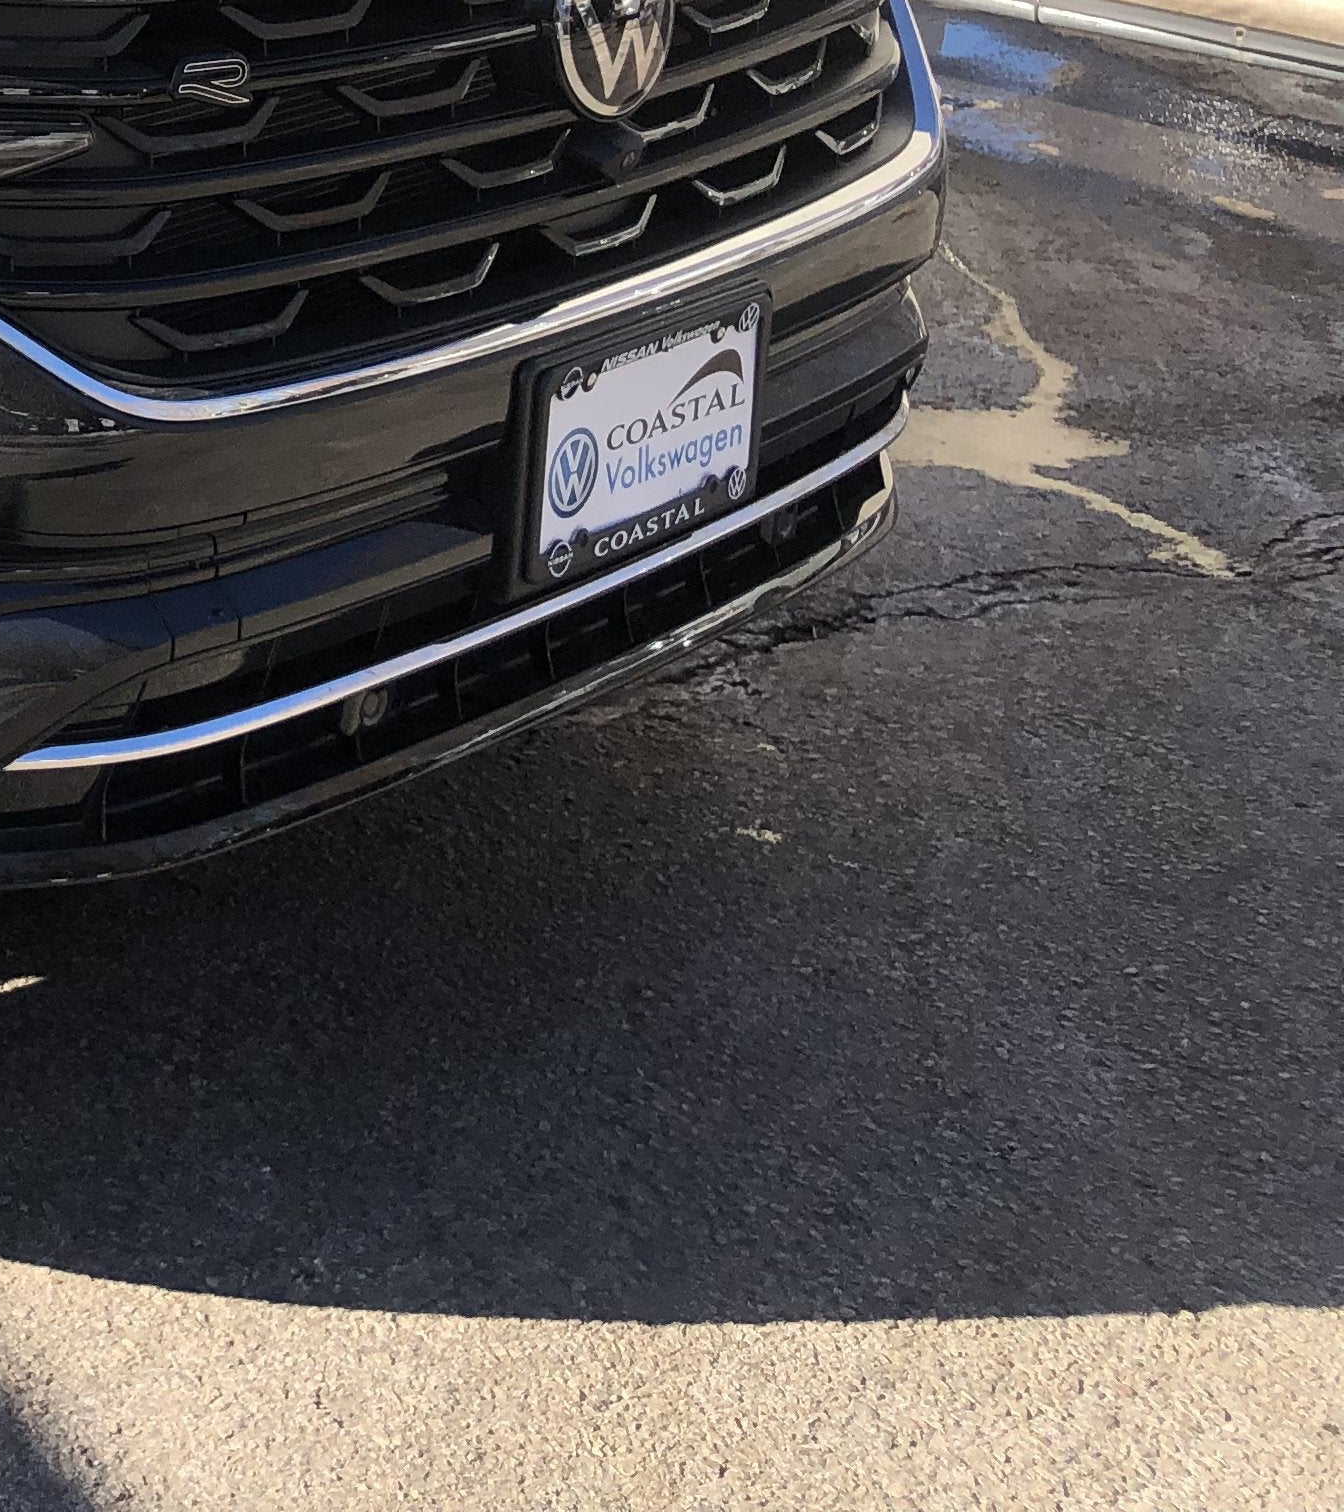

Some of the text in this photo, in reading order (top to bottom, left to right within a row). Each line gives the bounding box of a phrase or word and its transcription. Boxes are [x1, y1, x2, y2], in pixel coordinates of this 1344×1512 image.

[600, 340, 660, 373] NISSAN
[606, 383, 746, 451] COASTAL
[606, 423, 743, 495] Volkswagen
[593, 497, 705, 558] COASTAL
